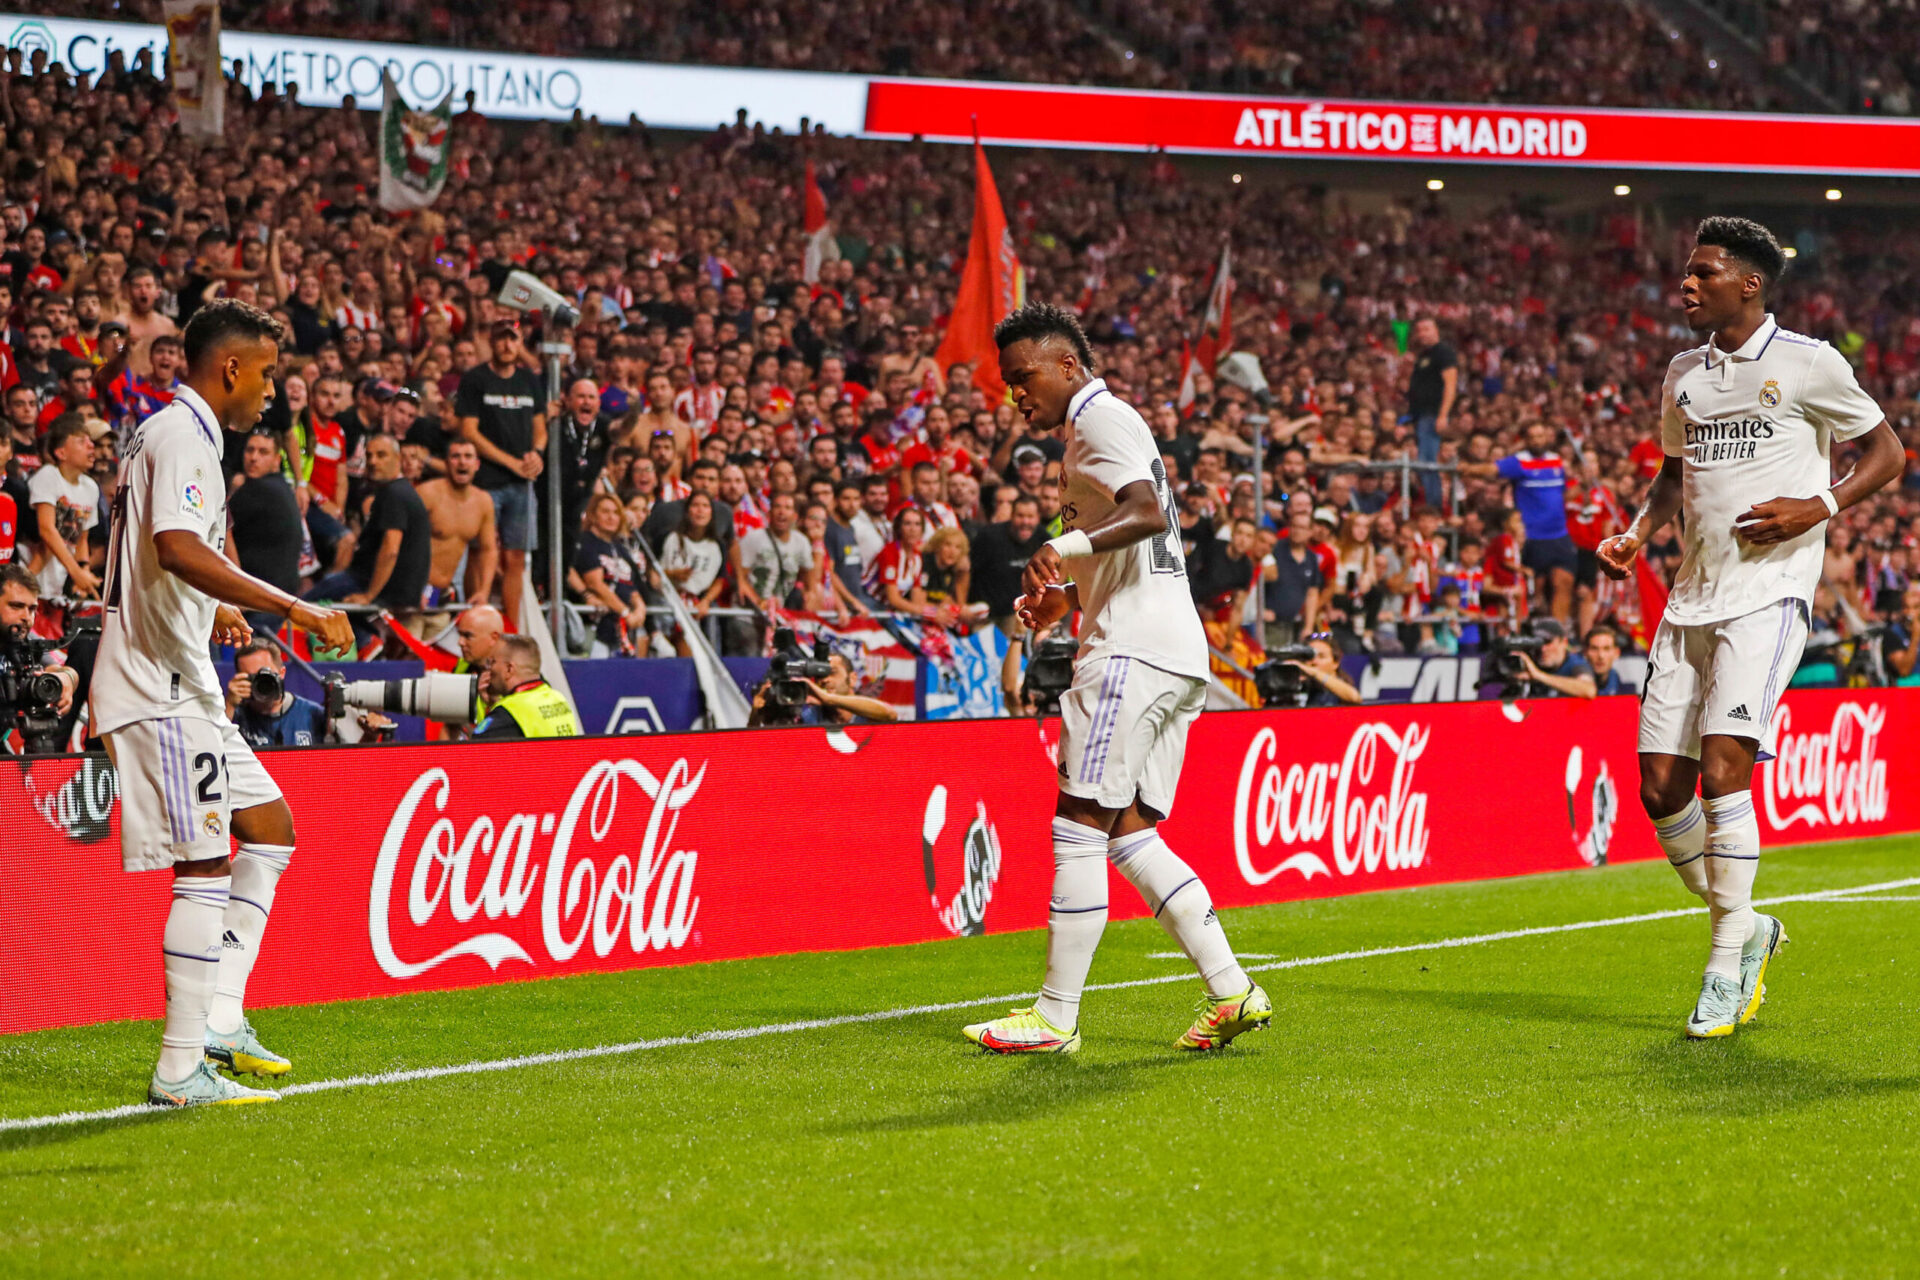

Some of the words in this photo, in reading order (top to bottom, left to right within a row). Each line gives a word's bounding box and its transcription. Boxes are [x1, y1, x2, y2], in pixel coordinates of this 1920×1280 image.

[249, 48, 582, 110] METROPOLITANO
[1234, 102, 1407, 151] ATLÉTICO
[1411, 122, 1435, 145] DE
[1441, 115, 1588, 157] MADRID
[1684, 418, 1774, 445] Emirates
[1712, 441, 1757, 461] BETTER
[1727, 711, 1752, 722] adidas
[1763, 702, 1890, 831] Coca-Cola
[1233, 721, 1431, 886] Coca-Cola
[368, 757, 709, 979] Coca-Cola
